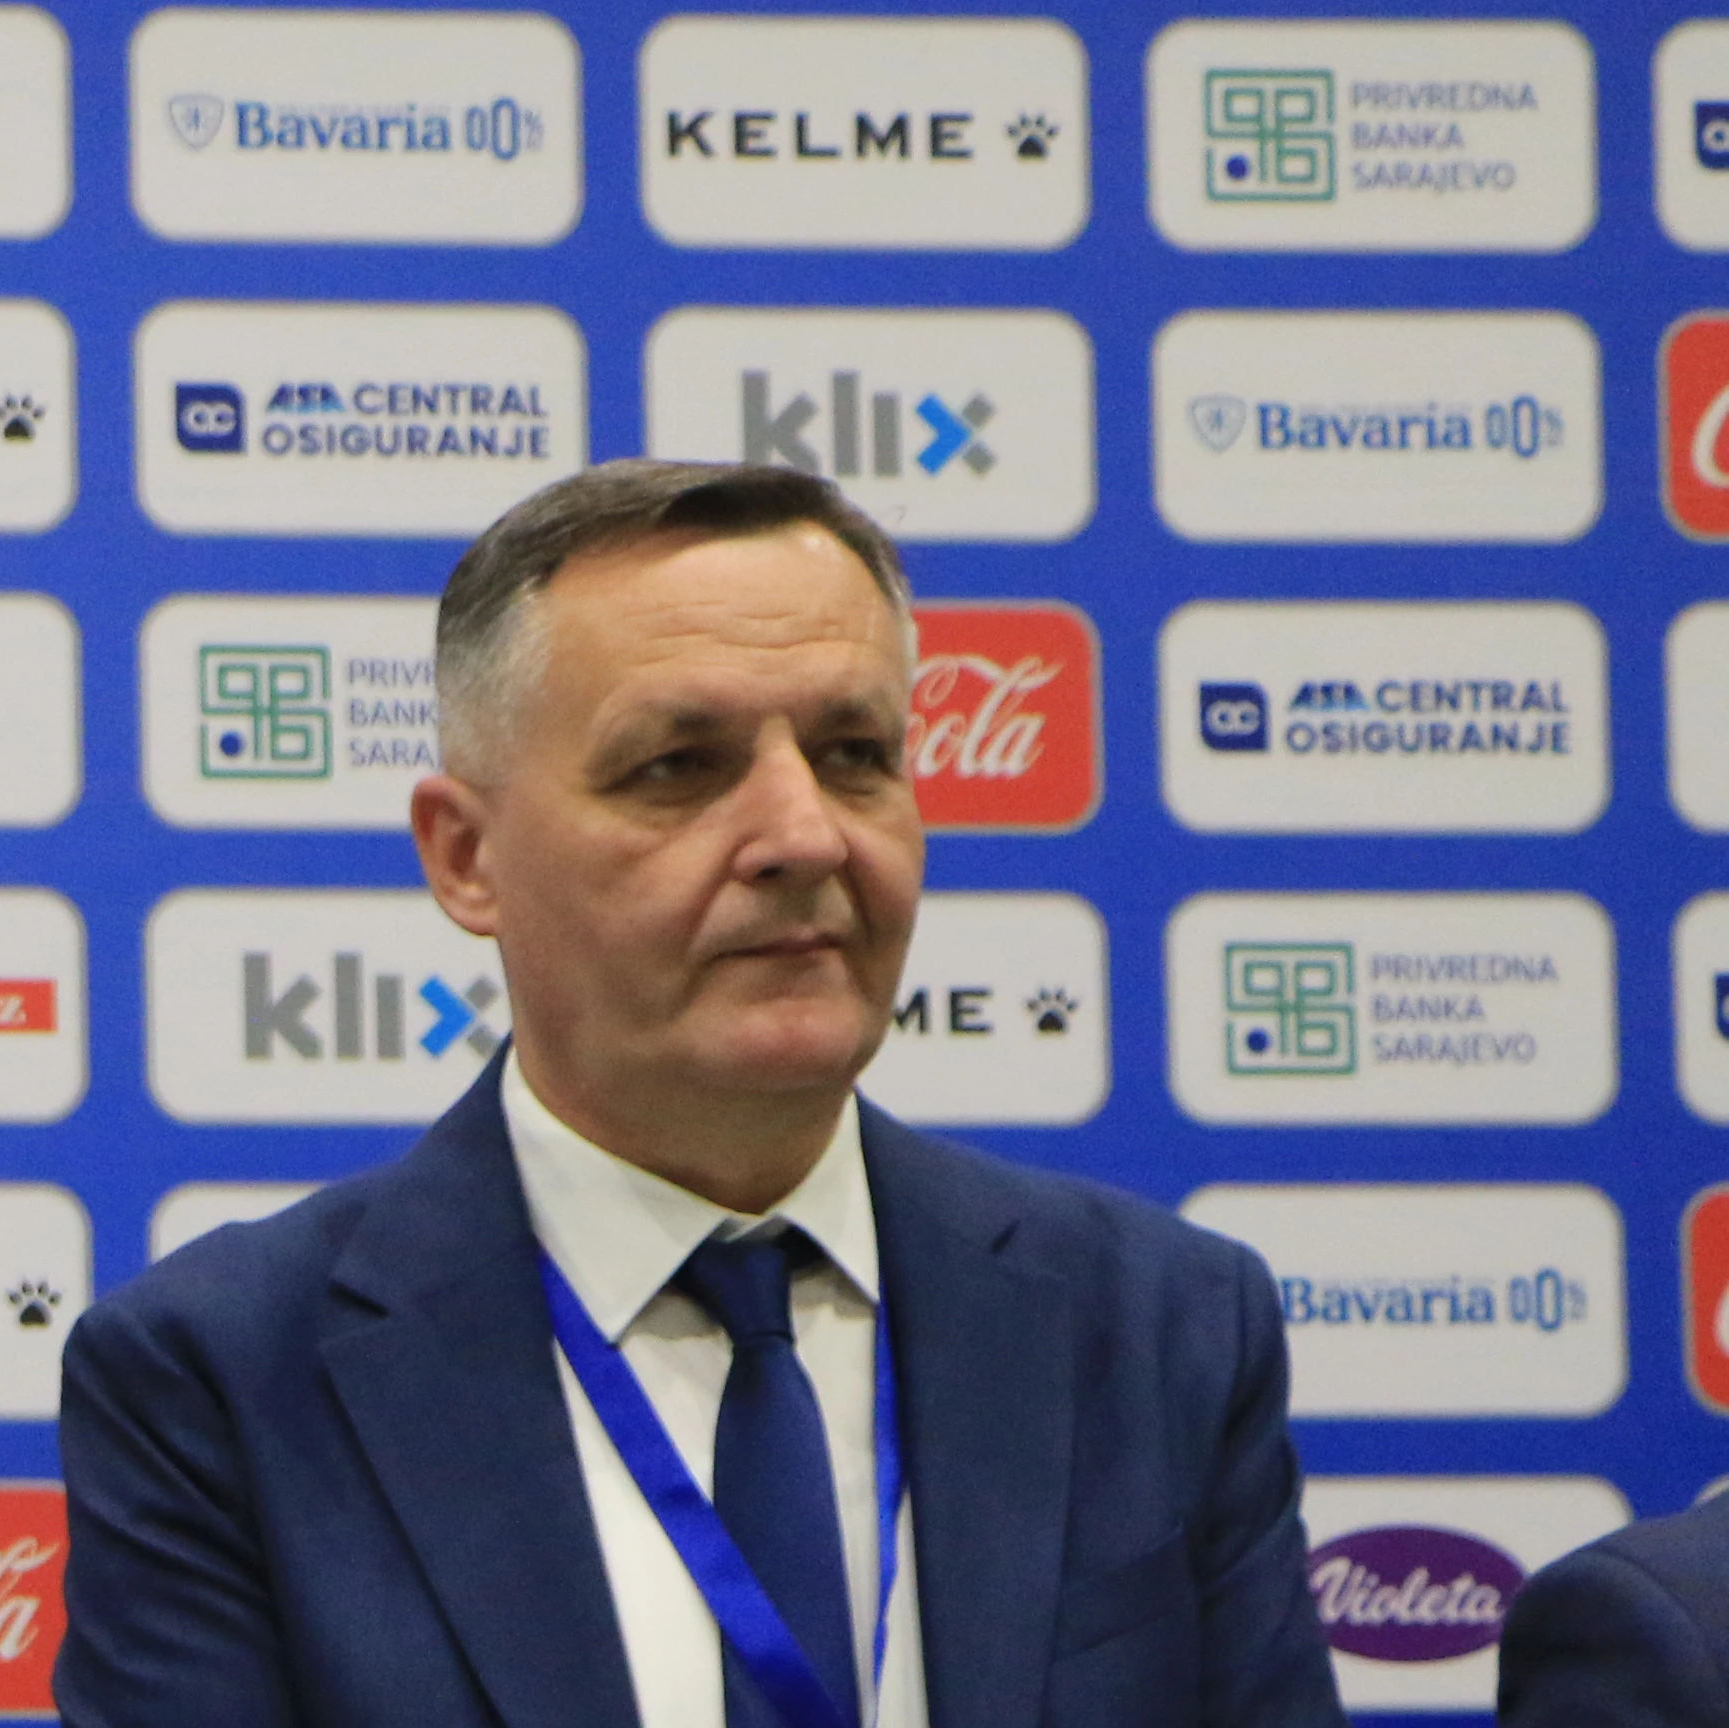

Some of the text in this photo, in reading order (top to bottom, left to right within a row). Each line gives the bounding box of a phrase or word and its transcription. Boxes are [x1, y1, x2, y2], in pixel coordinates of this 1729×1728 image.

[1350, 82, 1537, 112] PRIVREDNA
[235, 103, 451, 150] Bavaria
[667, 112, 971, 159] KELME
[1351, 123, 1463, 150] BANKA
[1351, 162, 1515, 195] SARAJEVO
[353, 384, 544, 418] CENTRAL
[741, 371, 996, 478] klix
[1257, 403, 1473, 450] Bavaria
[262, 424, 546, 459] OSIGURANJE
[1375, 681, 1566, 714] CENTRAL
[1285, 722, 1567, 755] OSIGURANJE
[1370, 955, 1558, 983] PRIVREDNA
[1372, 996, 1484, 1023] BANKA
[1372, 1033, 1536, 1066] SARAJEVO
[1281, 1277, 1498, 1325] Bavaria
[1310, 1557, 1506, 1626] Violeta
